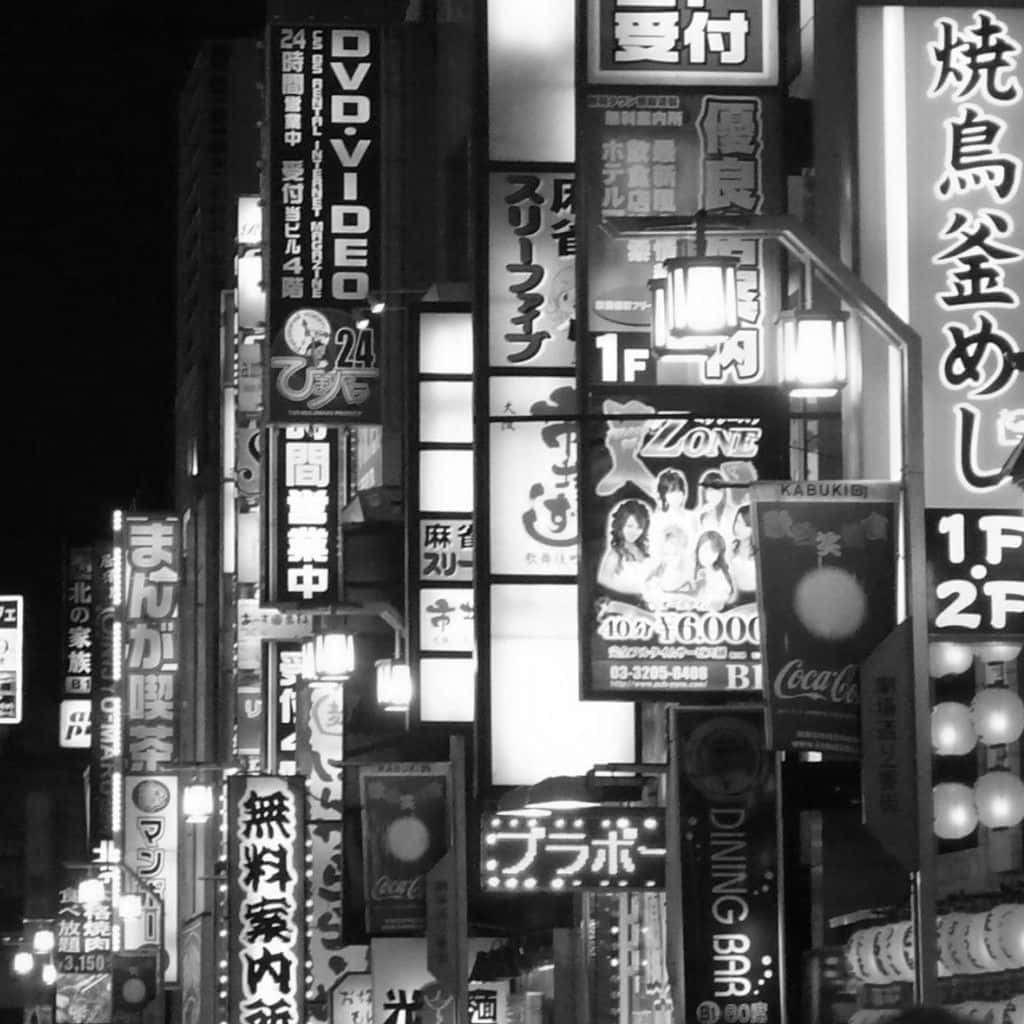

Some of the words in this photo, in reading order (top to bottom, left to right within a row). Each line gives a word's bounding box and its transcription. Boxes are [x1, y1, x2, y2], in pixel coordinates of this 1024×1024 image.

[614, 10, 749, 64] 受付
[595, 333, 650, 382] 1F
[938, 512, 1024, 566] 1F
[936, 581, 1024, 629] 2F
[710, 808, 749, 924] DINING
[712, 933, 752, 997] BAR
